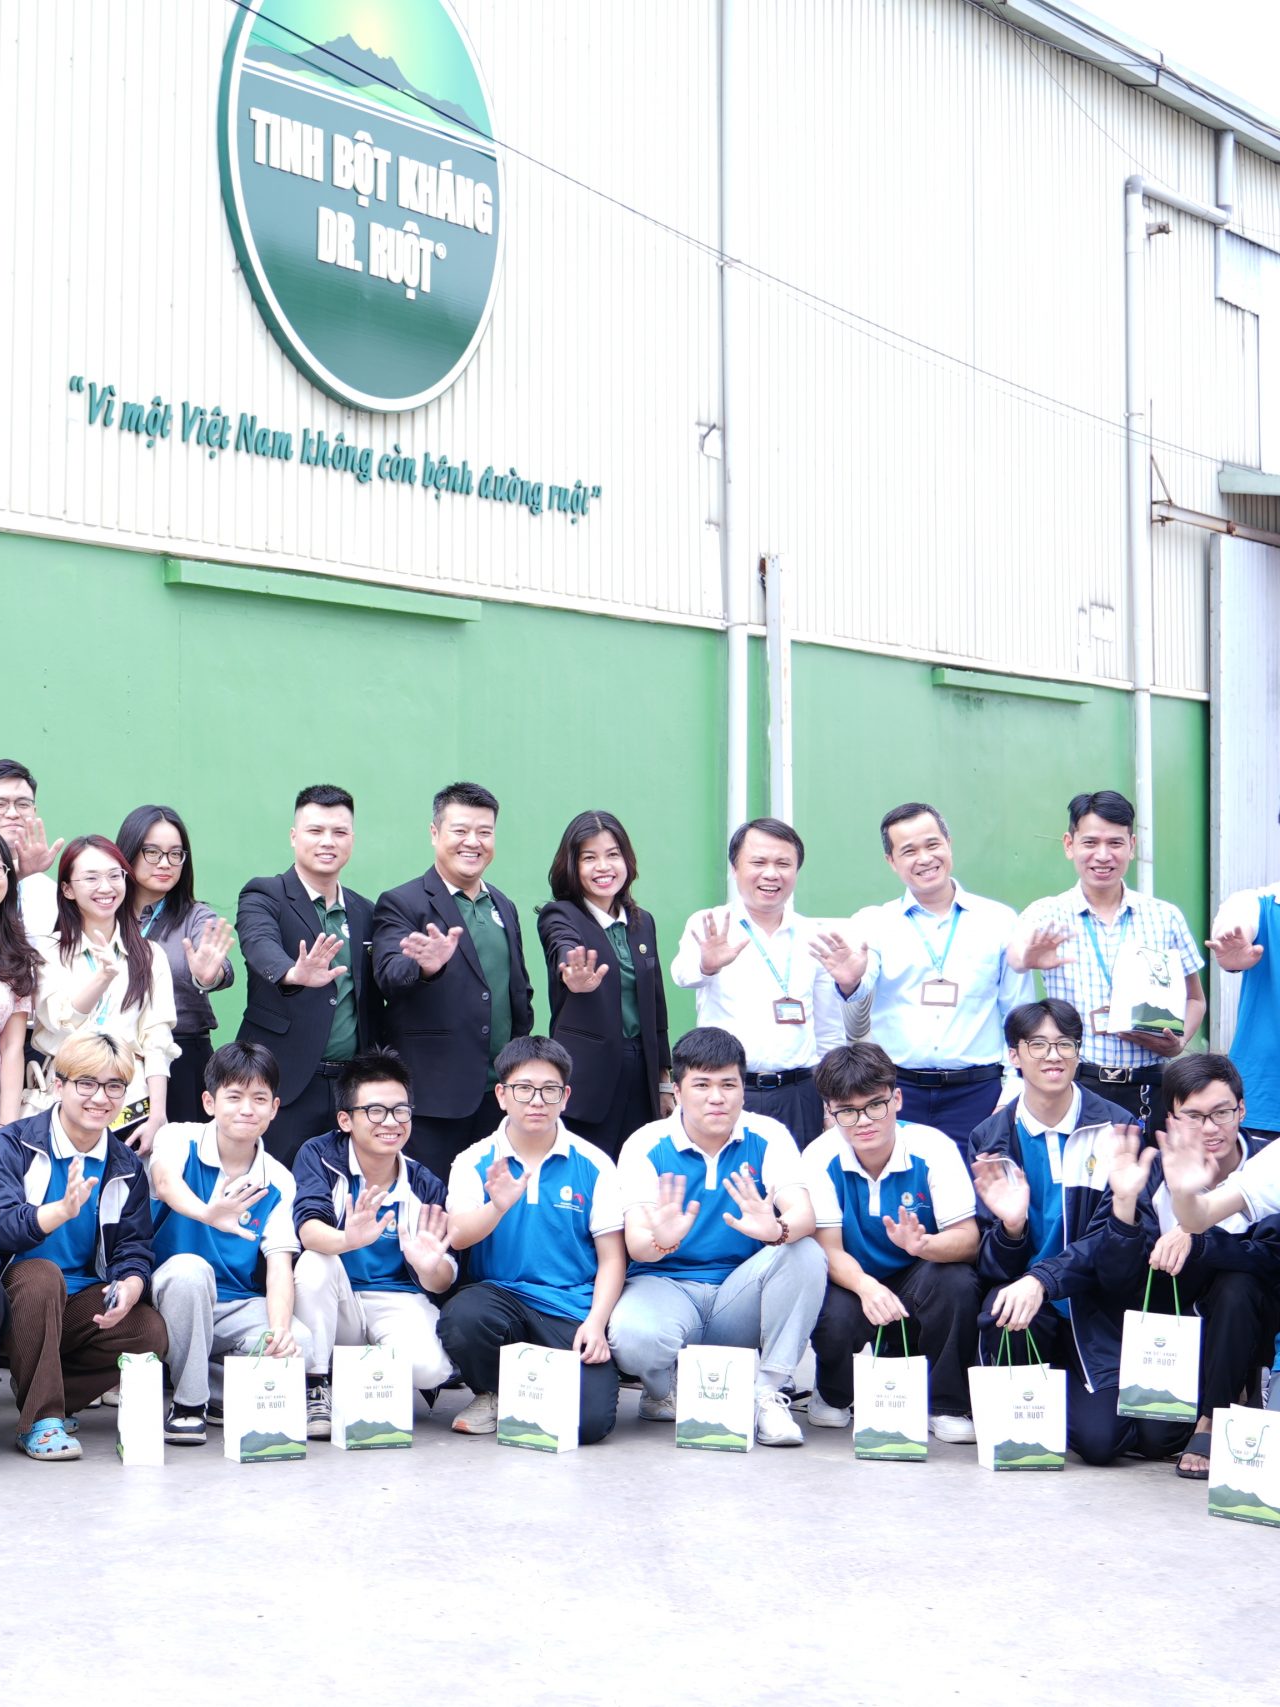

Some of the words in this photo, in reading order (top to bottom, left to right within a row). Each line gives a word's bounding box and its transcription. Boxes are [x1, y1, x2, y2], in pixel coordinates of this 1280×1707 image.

[249, 107, 324, 183] TINH
[331, 130, 392, 208] BỘT
[397, 159, 494, 235] KHÁNG
[317, 205, 363, 272] DR.
[120, 396, 174, 448] một
[181, 401, 232, 459] Việt
[235, 413, 294, 460] Nam
[300, 427, 373, 484] không
[378, 443, 417, 485] còn
[422, 452, 474, 500] bệnh
[478, 465, 543, 516] đường
